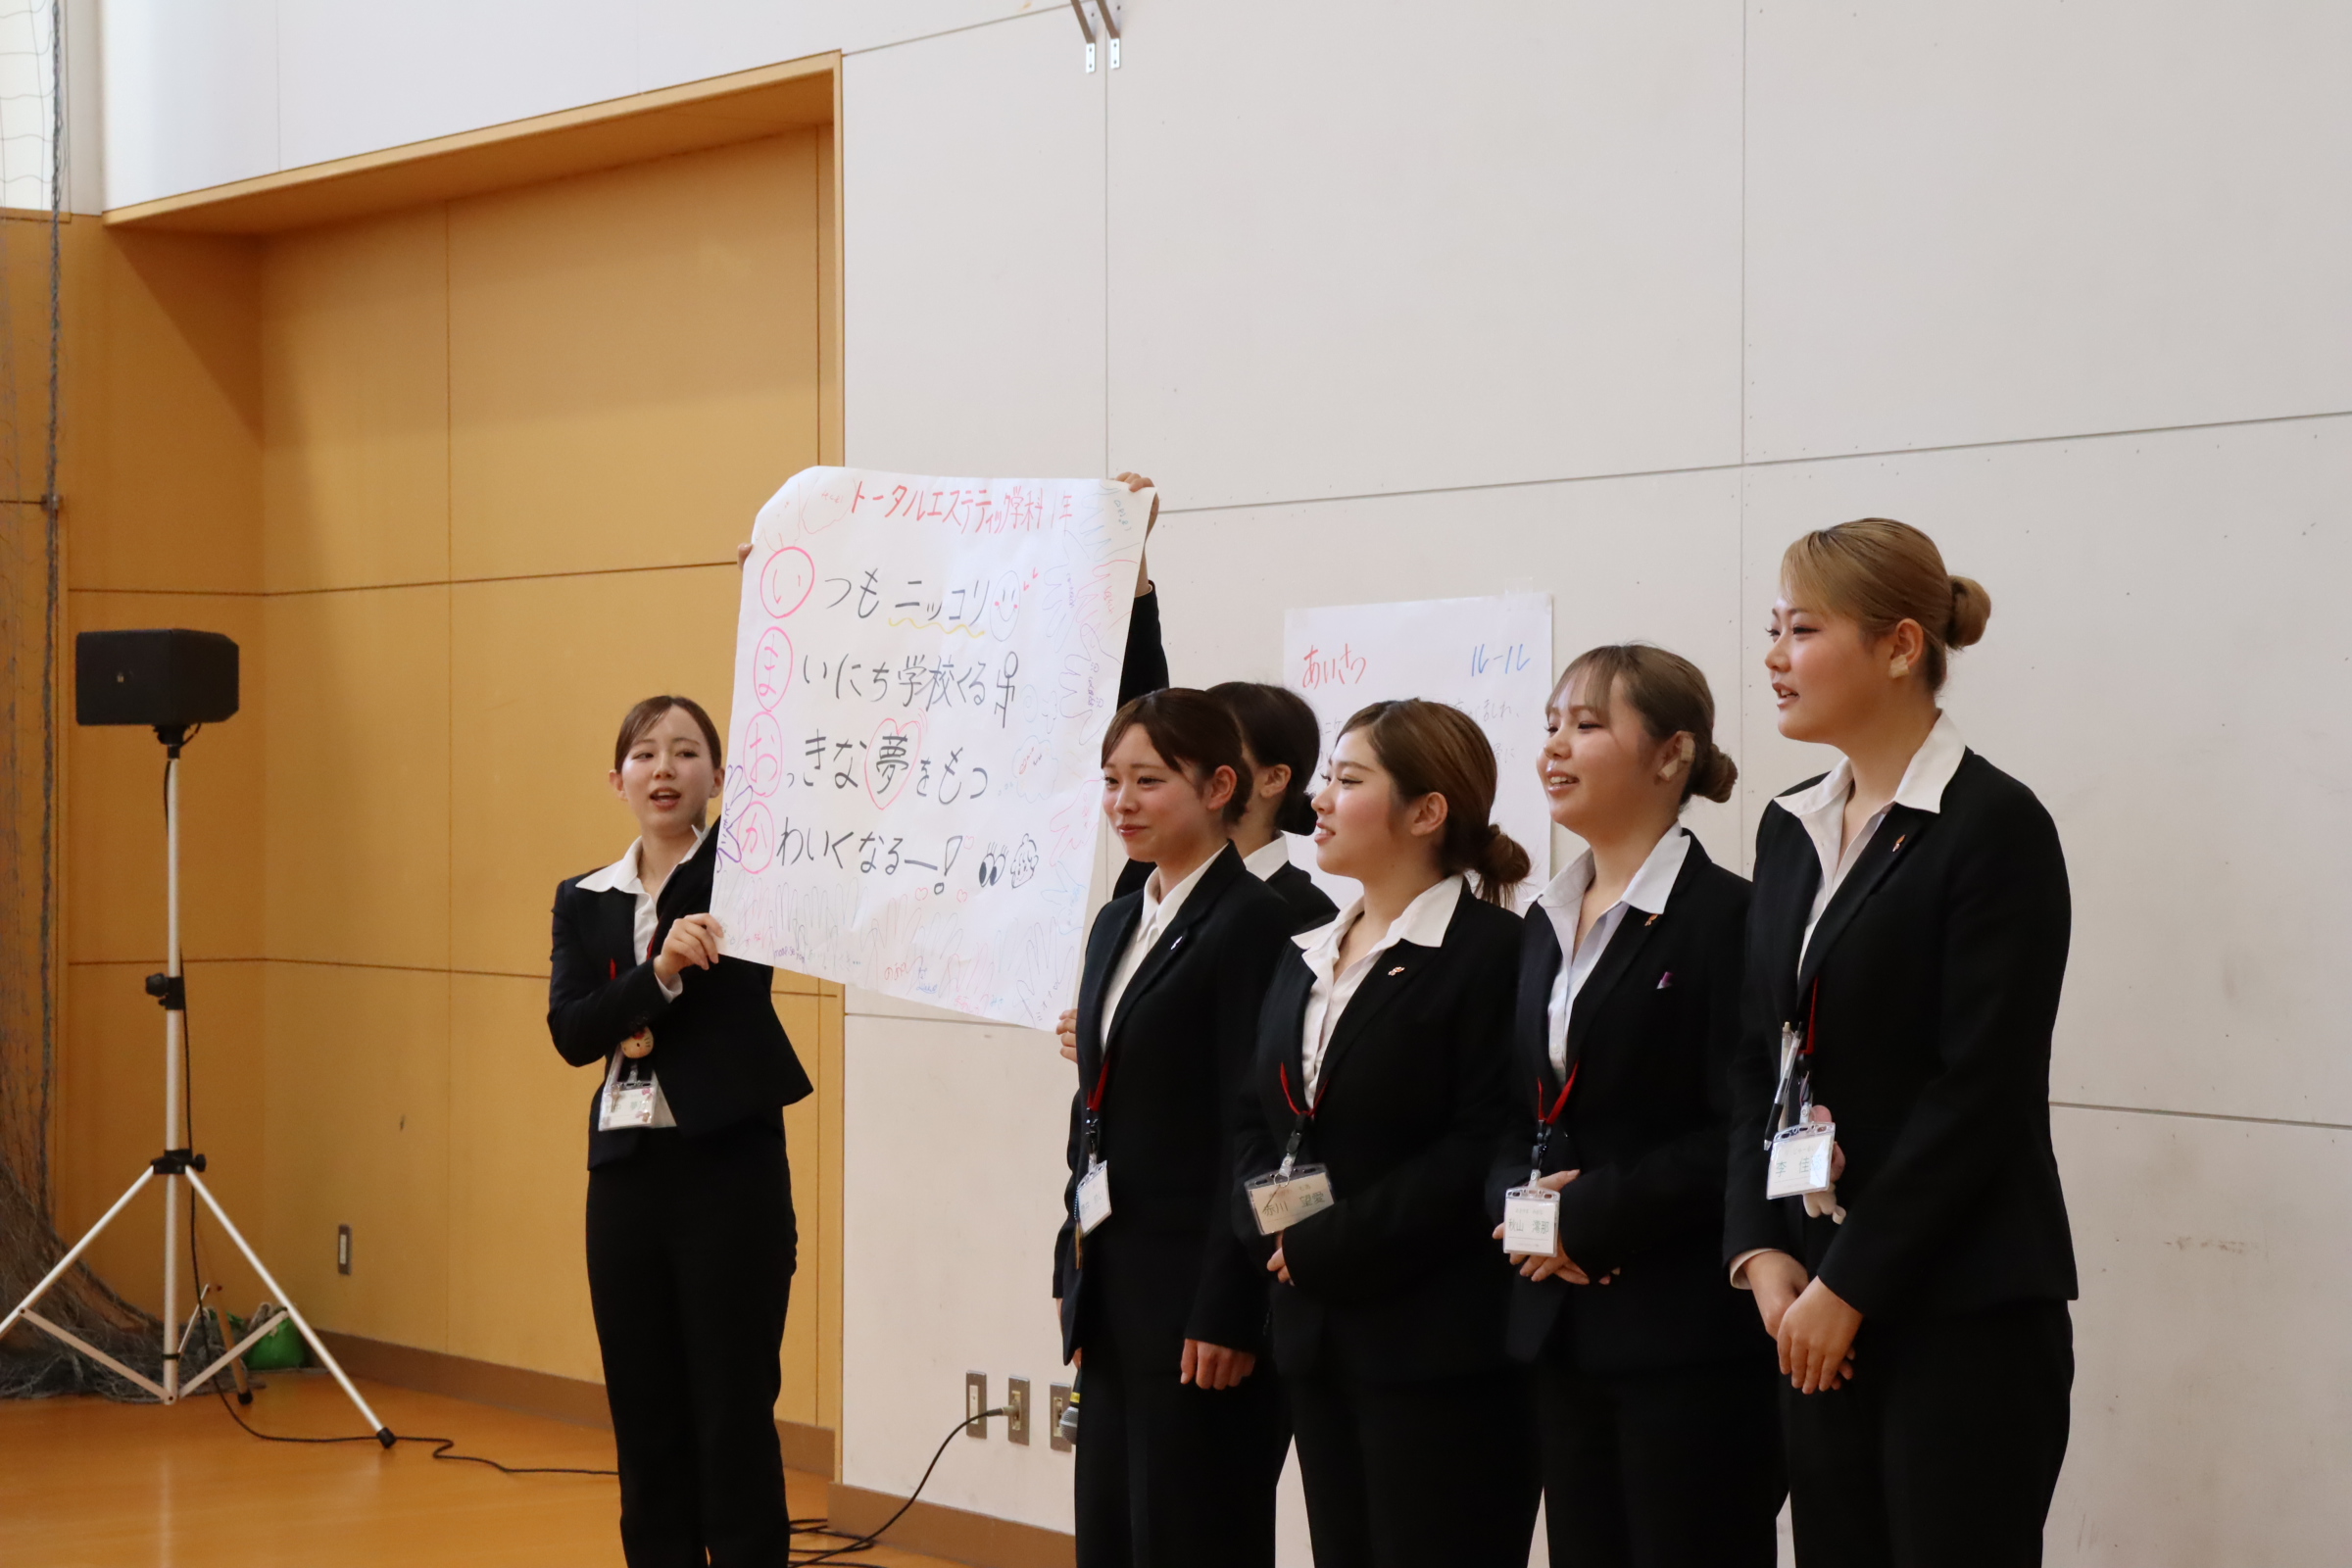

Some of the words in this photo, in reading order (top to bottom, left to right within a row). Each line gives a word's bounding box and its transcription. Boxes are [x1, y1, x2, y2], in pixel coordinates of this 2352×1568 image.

[1302, 643, 1368, 690] あいさつ
[1471, 643, 1532, 678] ルール
